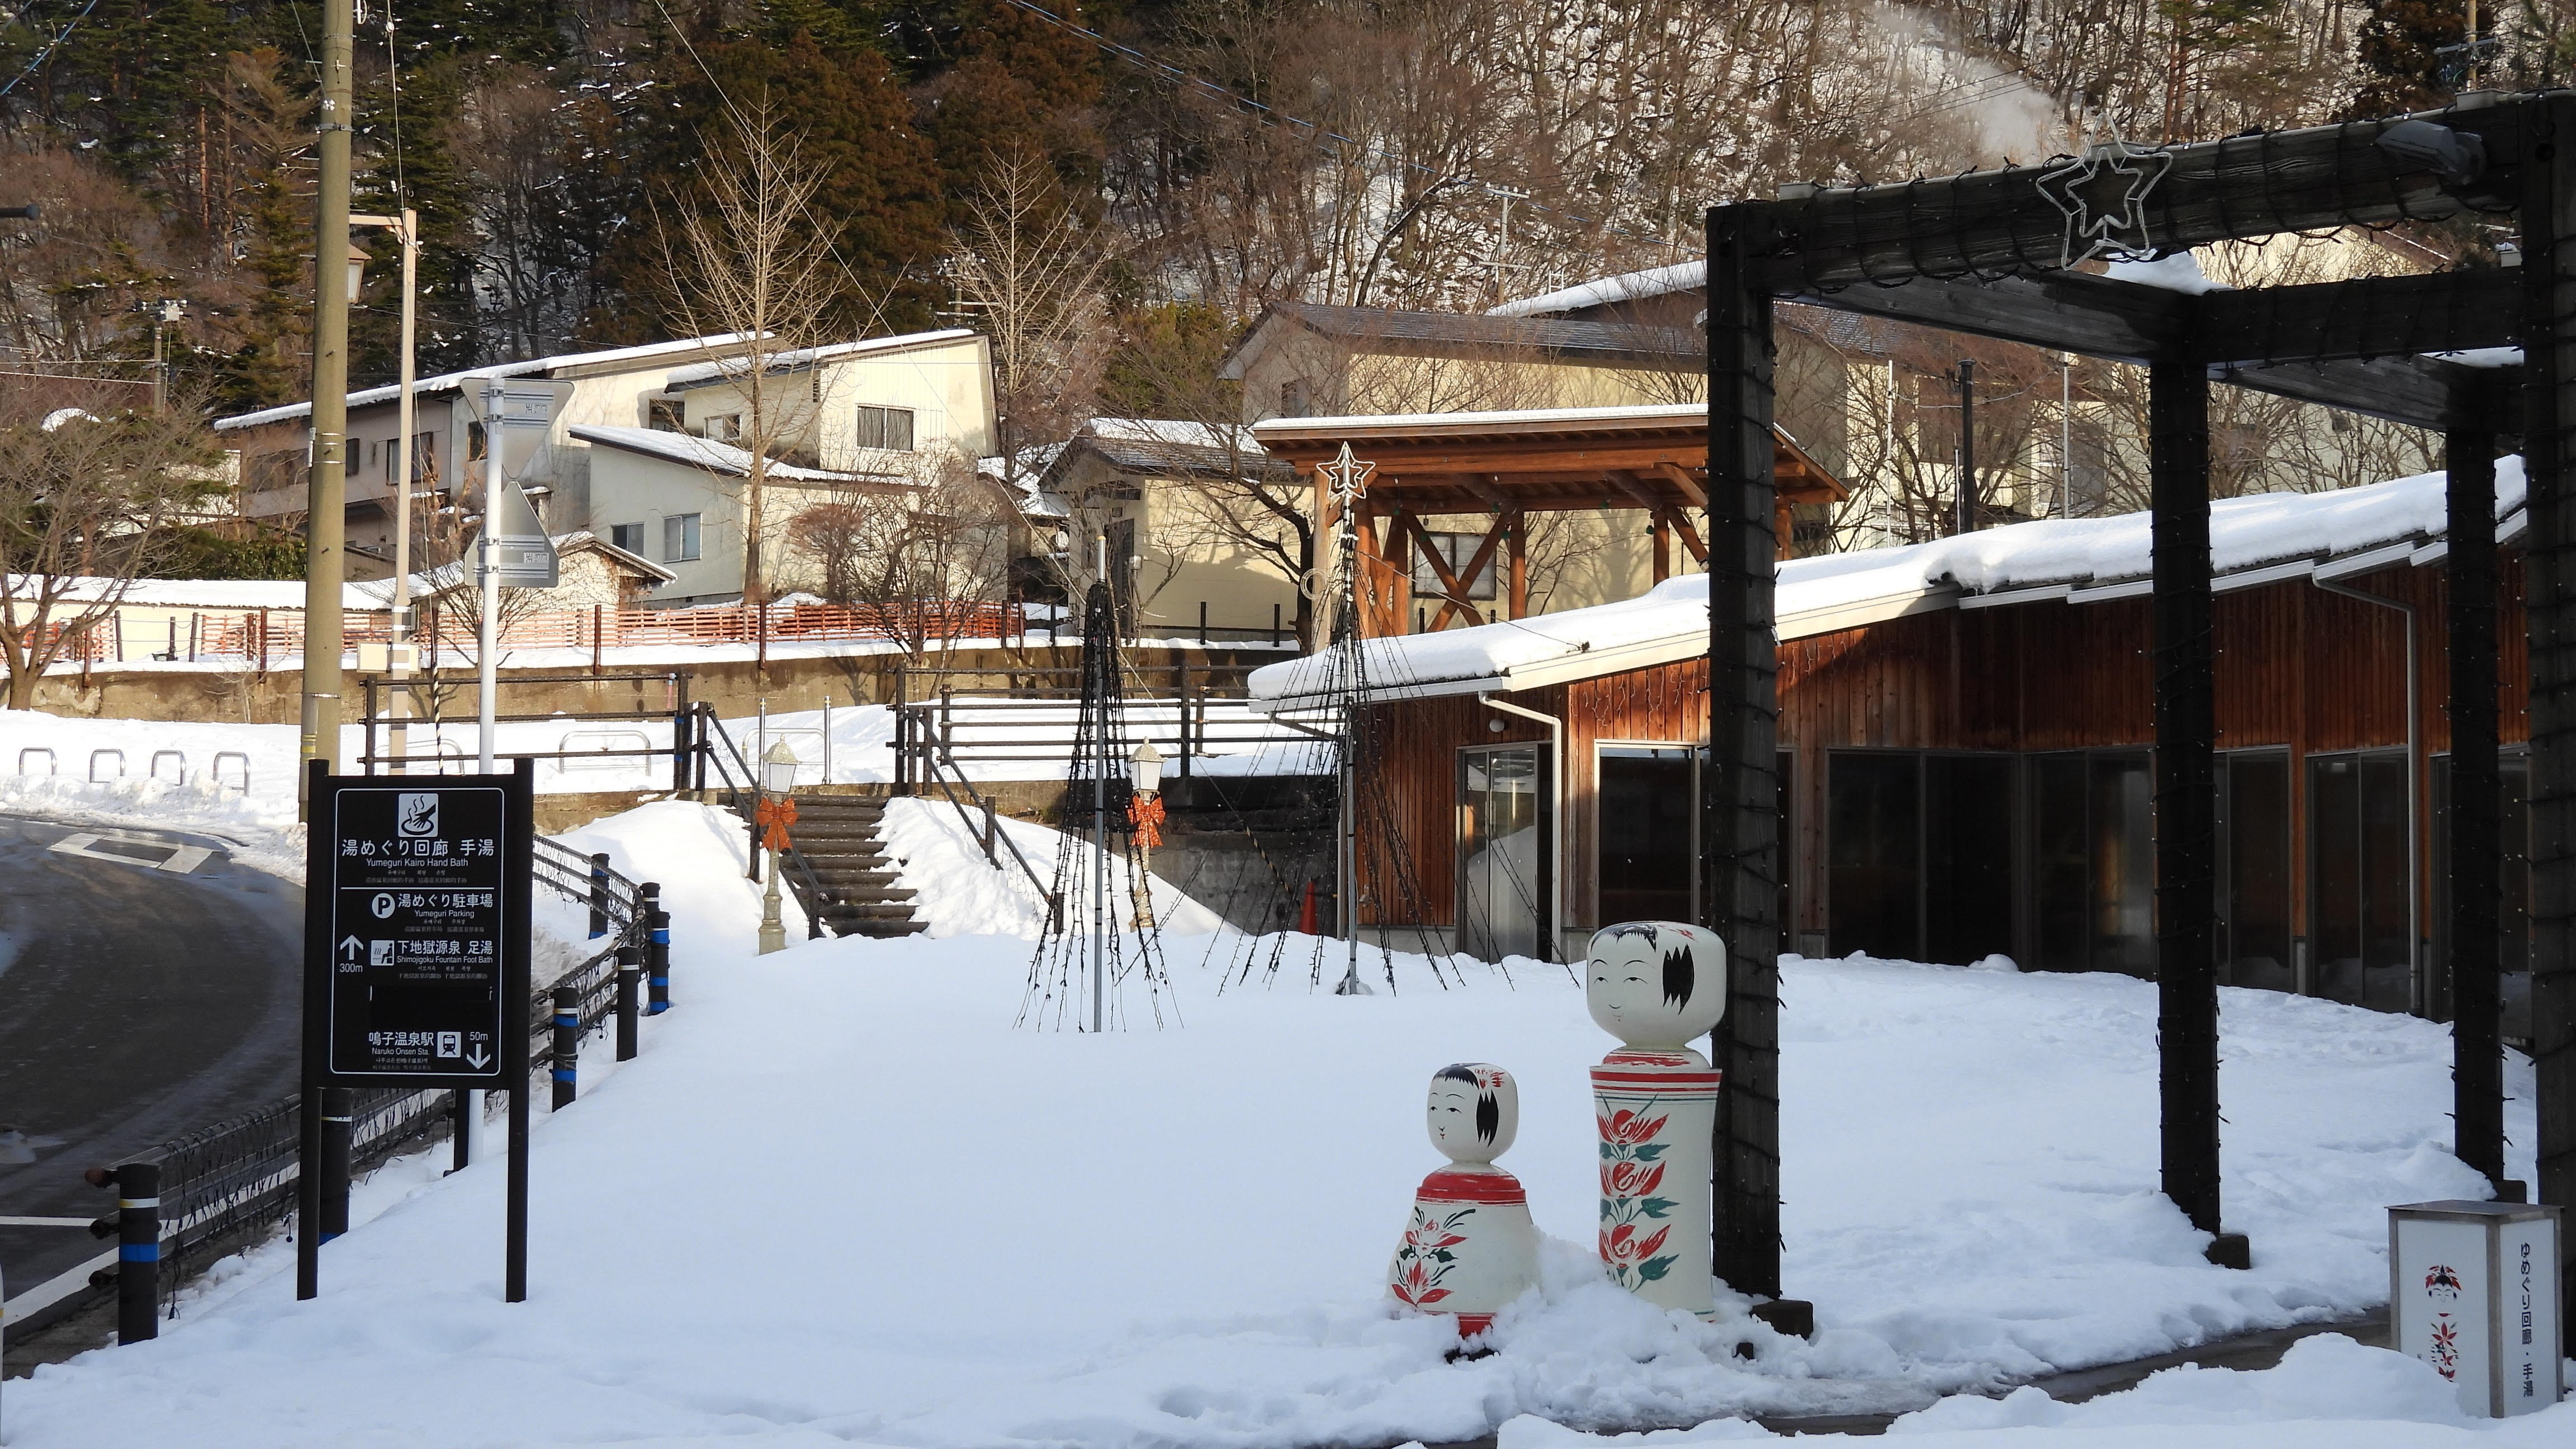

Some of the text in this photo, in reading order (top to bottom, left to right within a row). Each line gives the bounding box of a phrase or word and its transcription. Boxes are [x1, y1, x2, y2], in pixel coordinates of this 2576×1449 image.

[342, 839, 495, 856] 湯めぐり回廊 手湯
[366, 858, 468, 868] Yumeguri Kairo Hand Bath
[398, 893, 493, 908] 湯めぐり駐車場
[414, 910, 475, 918] Yumeguri Parking
[397, 940, 493, 954] 下地獄源泉 足湯
[397, 956, 434, 964] Shimojigoku
[339, 963, 363, 973] 300m
[368, 1031, 434, 1046] 鳴子温泉駅
[470, 1032, 488, 1041] 50m
